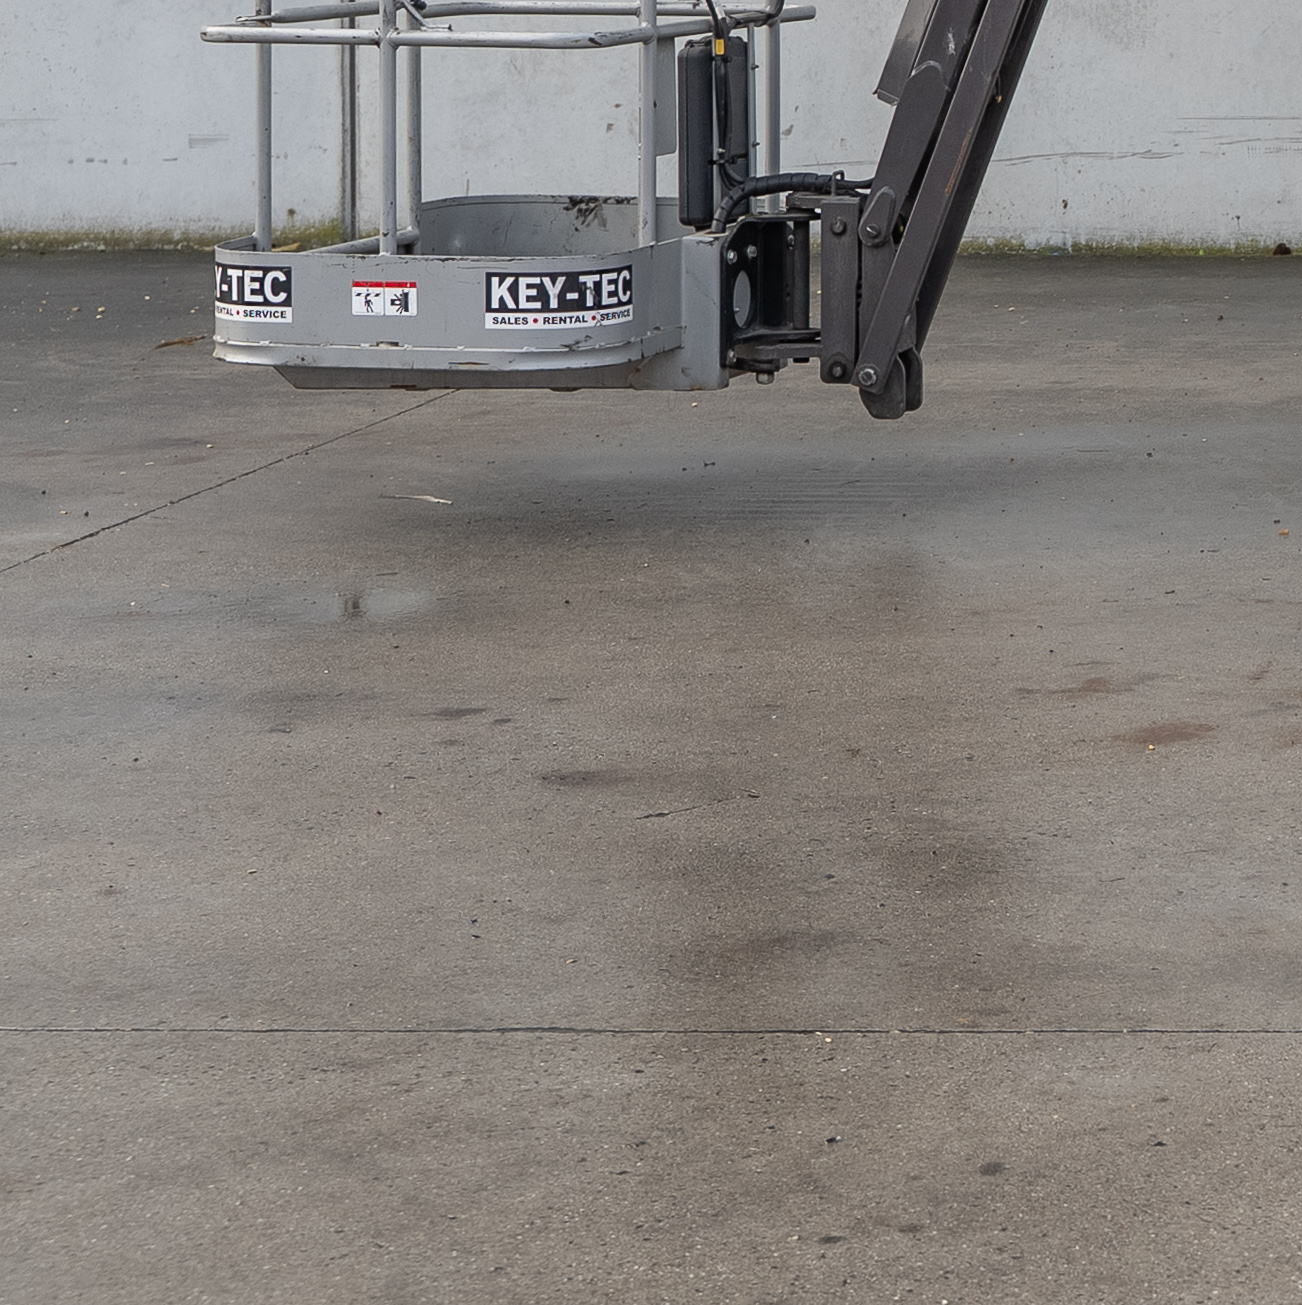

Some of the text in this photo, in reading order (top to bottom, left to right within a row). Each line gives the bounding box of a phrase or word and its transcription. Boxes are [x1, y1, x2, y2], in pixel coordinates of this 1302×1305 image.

[491, 269, 631, 310] KEY-TEC
[243, 309, 287, 319] SERVICE
[492, 308, 631, 325] SALES RENTAL SERVICE
